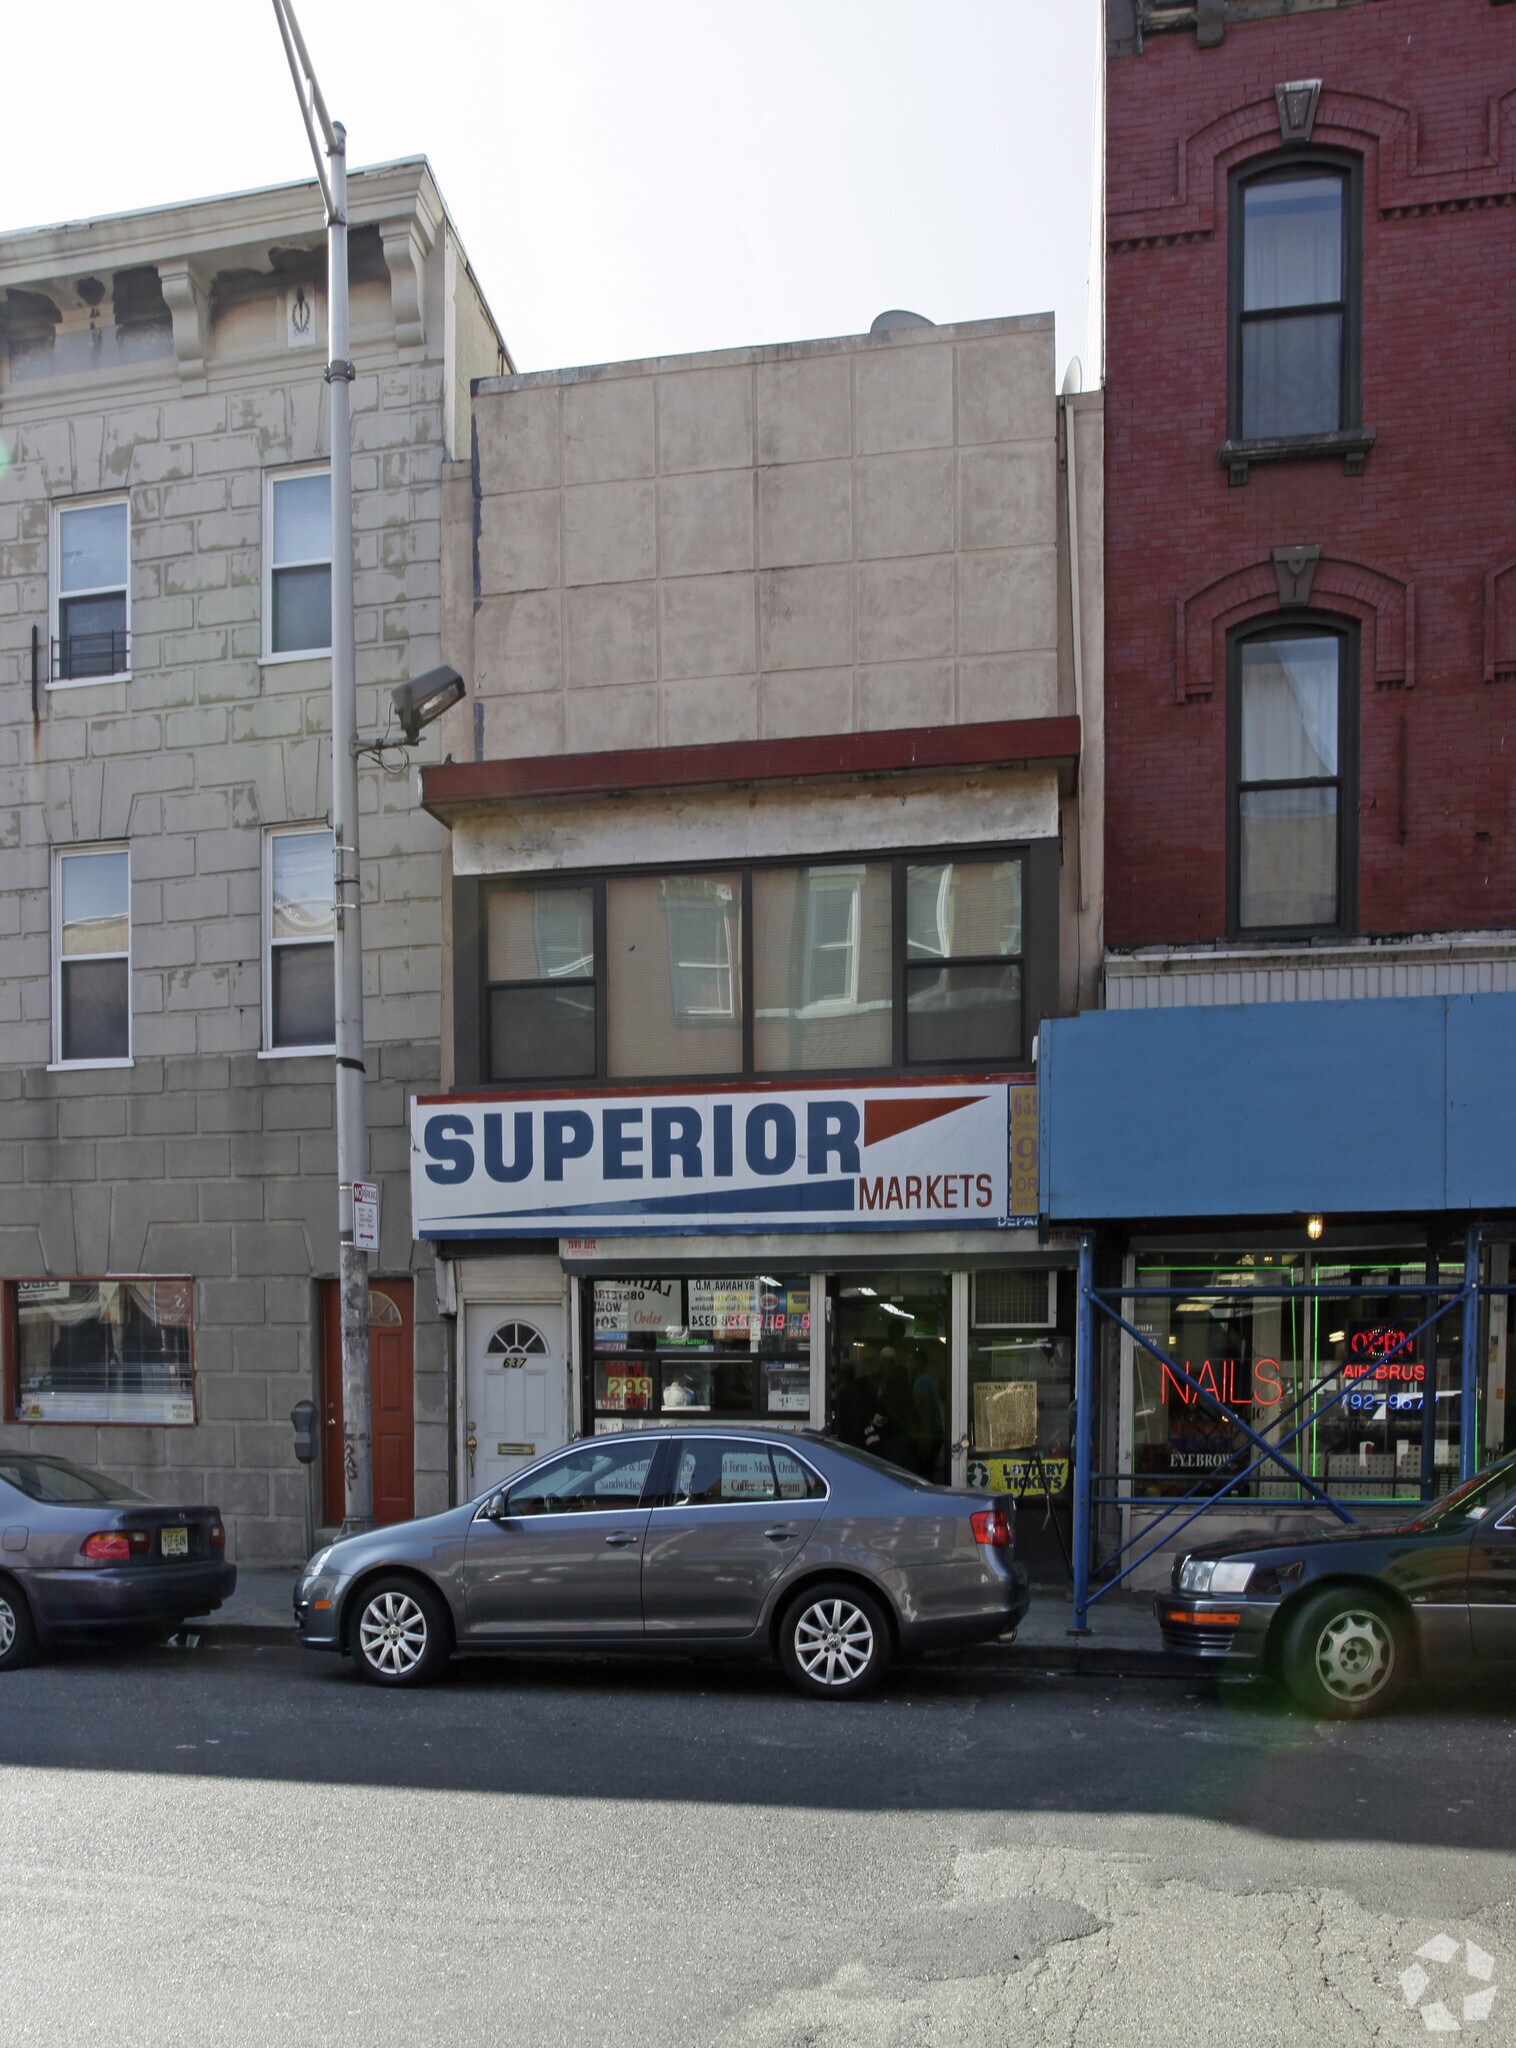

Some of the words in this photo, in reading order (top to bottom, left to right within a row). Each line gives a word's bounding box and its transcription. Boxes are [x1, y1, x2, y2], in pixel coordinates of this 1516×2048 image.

[423, 1100, 862, 1186] SUPERIOR
[354, 1186, 362, 1200] NO
[858, 1173, 993, 1211] MARKETS
[997, 1217, 1038, 1227] DEPA
[633, 1310, 663, 1325] Order
[1351, 1331, 1414, 1354] OPEN
[503, 1357, 527, 1369] 637
[606, 1361, 645, 1378] MILK
[1375, 1364, 1426, 1381] BRUS
[994, 1384, 1034, 1392] WINNERS
[1161, 1357, 1283, 1405] NAILS
[778, 1461, 799, 1474] Order
[1002, 1463, 1066, 1477] LOTTERY
[731, 1480, 756, 1492] Coffee
[779, 1481, 800, 1492] ream
[1005, 1477, 1064, 1490] TICKETS
